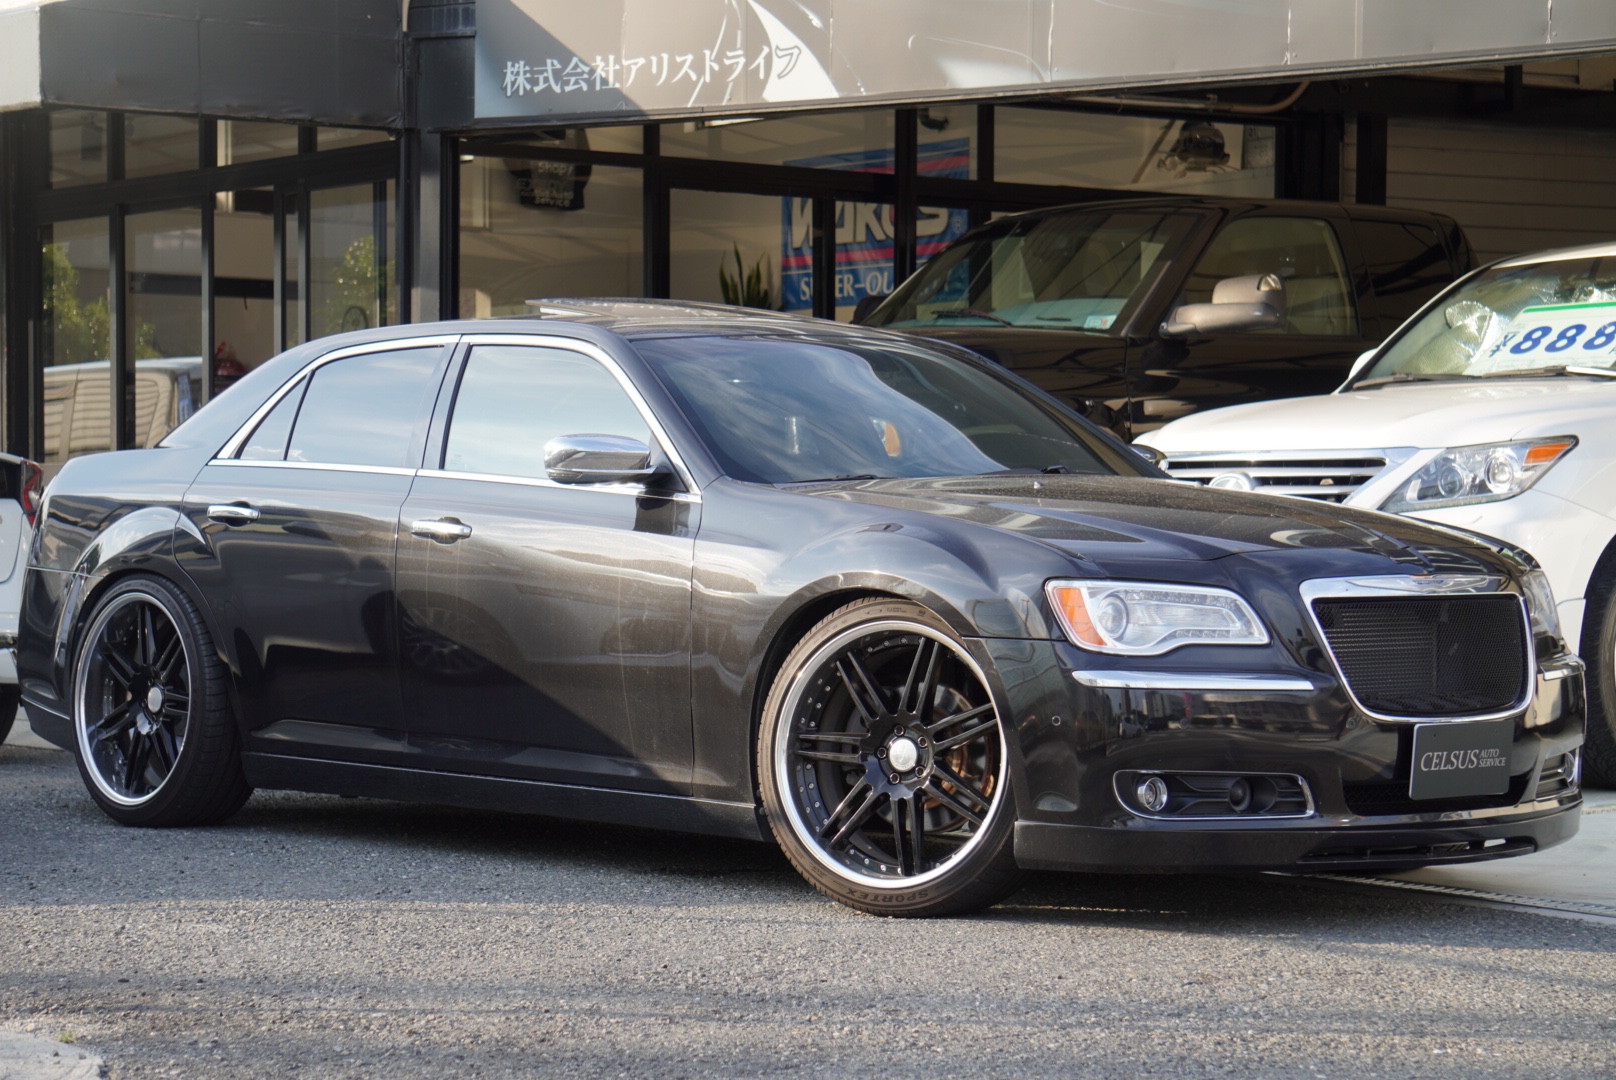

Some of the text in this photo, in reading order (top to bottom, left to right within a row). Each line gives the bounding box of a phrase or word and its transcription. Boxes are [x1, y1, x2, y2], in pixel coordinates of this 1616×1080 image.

[502, 44, 802, 97] 株式会社アリストライフ
[1420, 748, 1499, 772] CELSUS AUTO
[1478, 757, 1507, 768] SERVICE
